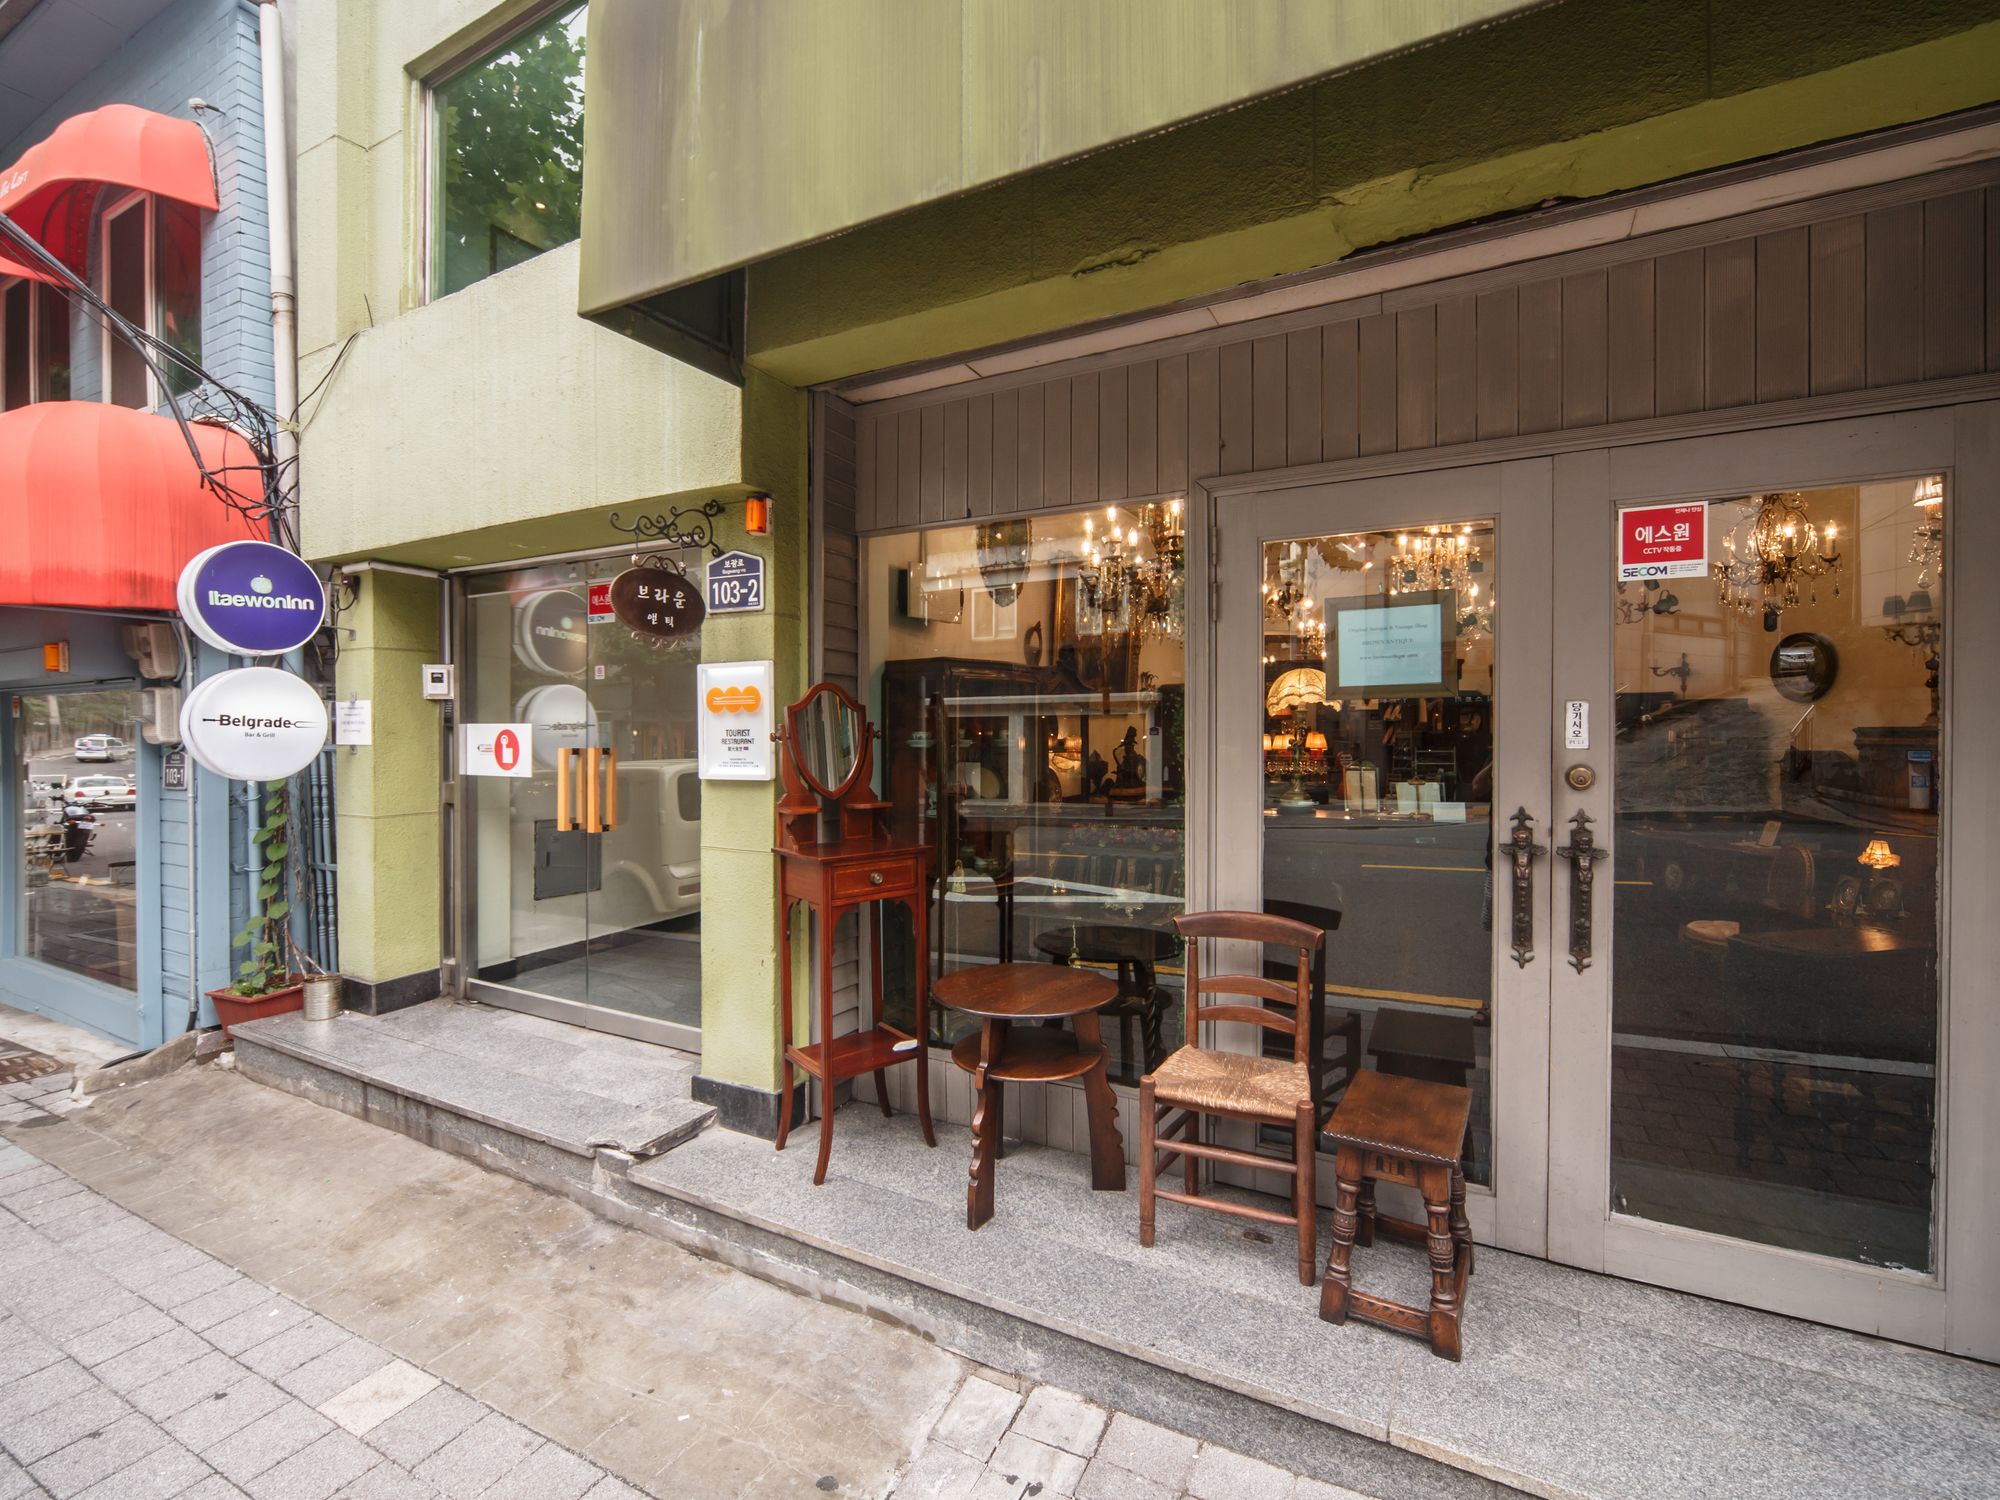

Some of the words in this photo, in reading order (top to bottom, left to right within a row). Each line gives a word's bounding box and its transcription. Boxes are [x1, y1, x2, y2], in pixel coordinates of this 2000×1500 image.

[1635, 522, 1690, 544] 에스원
[1643, 547, 1662, 555] CCTV
[724, 558, 744, 568] 보광로
[1623, 566, 1667, 578] SECOM
[637, 585, 686, 609] 브라운
[712, 579, 758, 605] 103-2
[647, 613, 674, 628] 앤틱
[219, 714, 292, 730] Belgrade
[1572, 702, 1582, 738] 당기시오
[725, 729, 751, 737] TOURIST
[166, 768, 184, 785] 103-1
